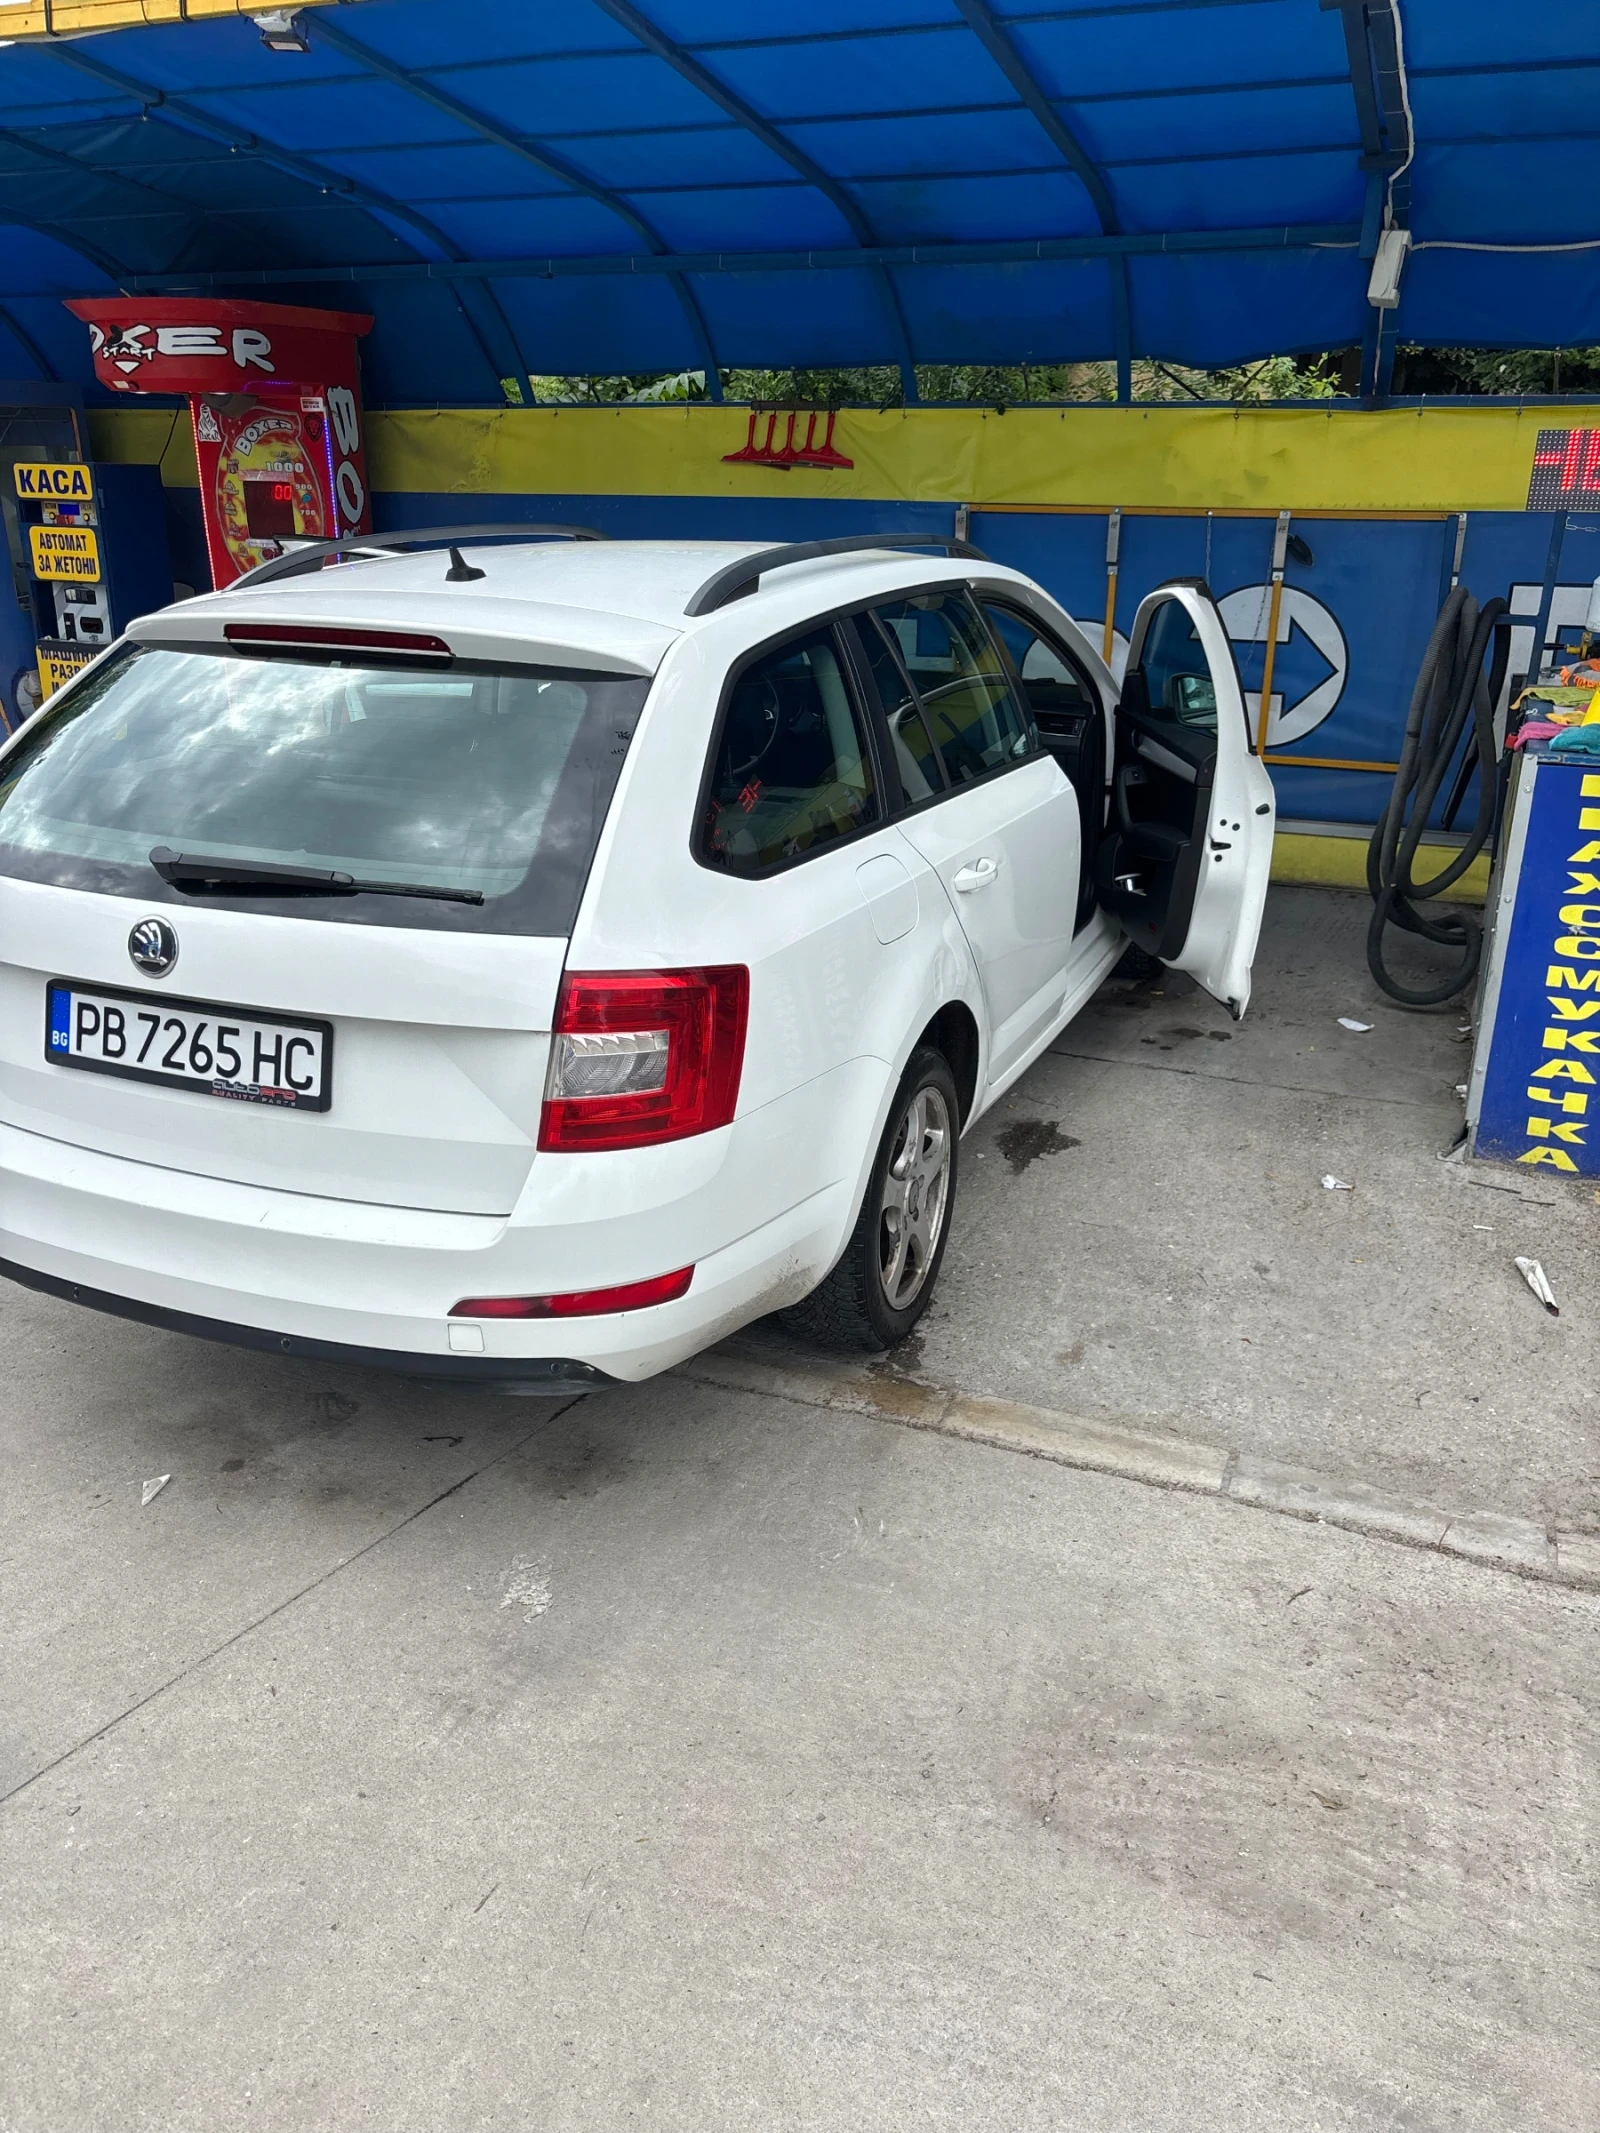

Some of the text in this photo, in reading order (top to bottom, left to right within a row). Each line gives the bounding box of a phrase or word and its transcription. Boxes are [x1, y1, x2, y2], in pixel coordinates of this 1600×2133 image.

[103, 346, 156, 361] START
[234, 418, 293, 457] BOXER
[265, 462, 304, 473] 1000
[18, 469, 88, 495] КАСА
[274, 485, 292, 500] 00
[39, 532, 87, 552] АВТОМАТ
[38, 554, 97, 575] ЗА ЖЕТОНИ
[52, 1030, 68, 1047] BG
